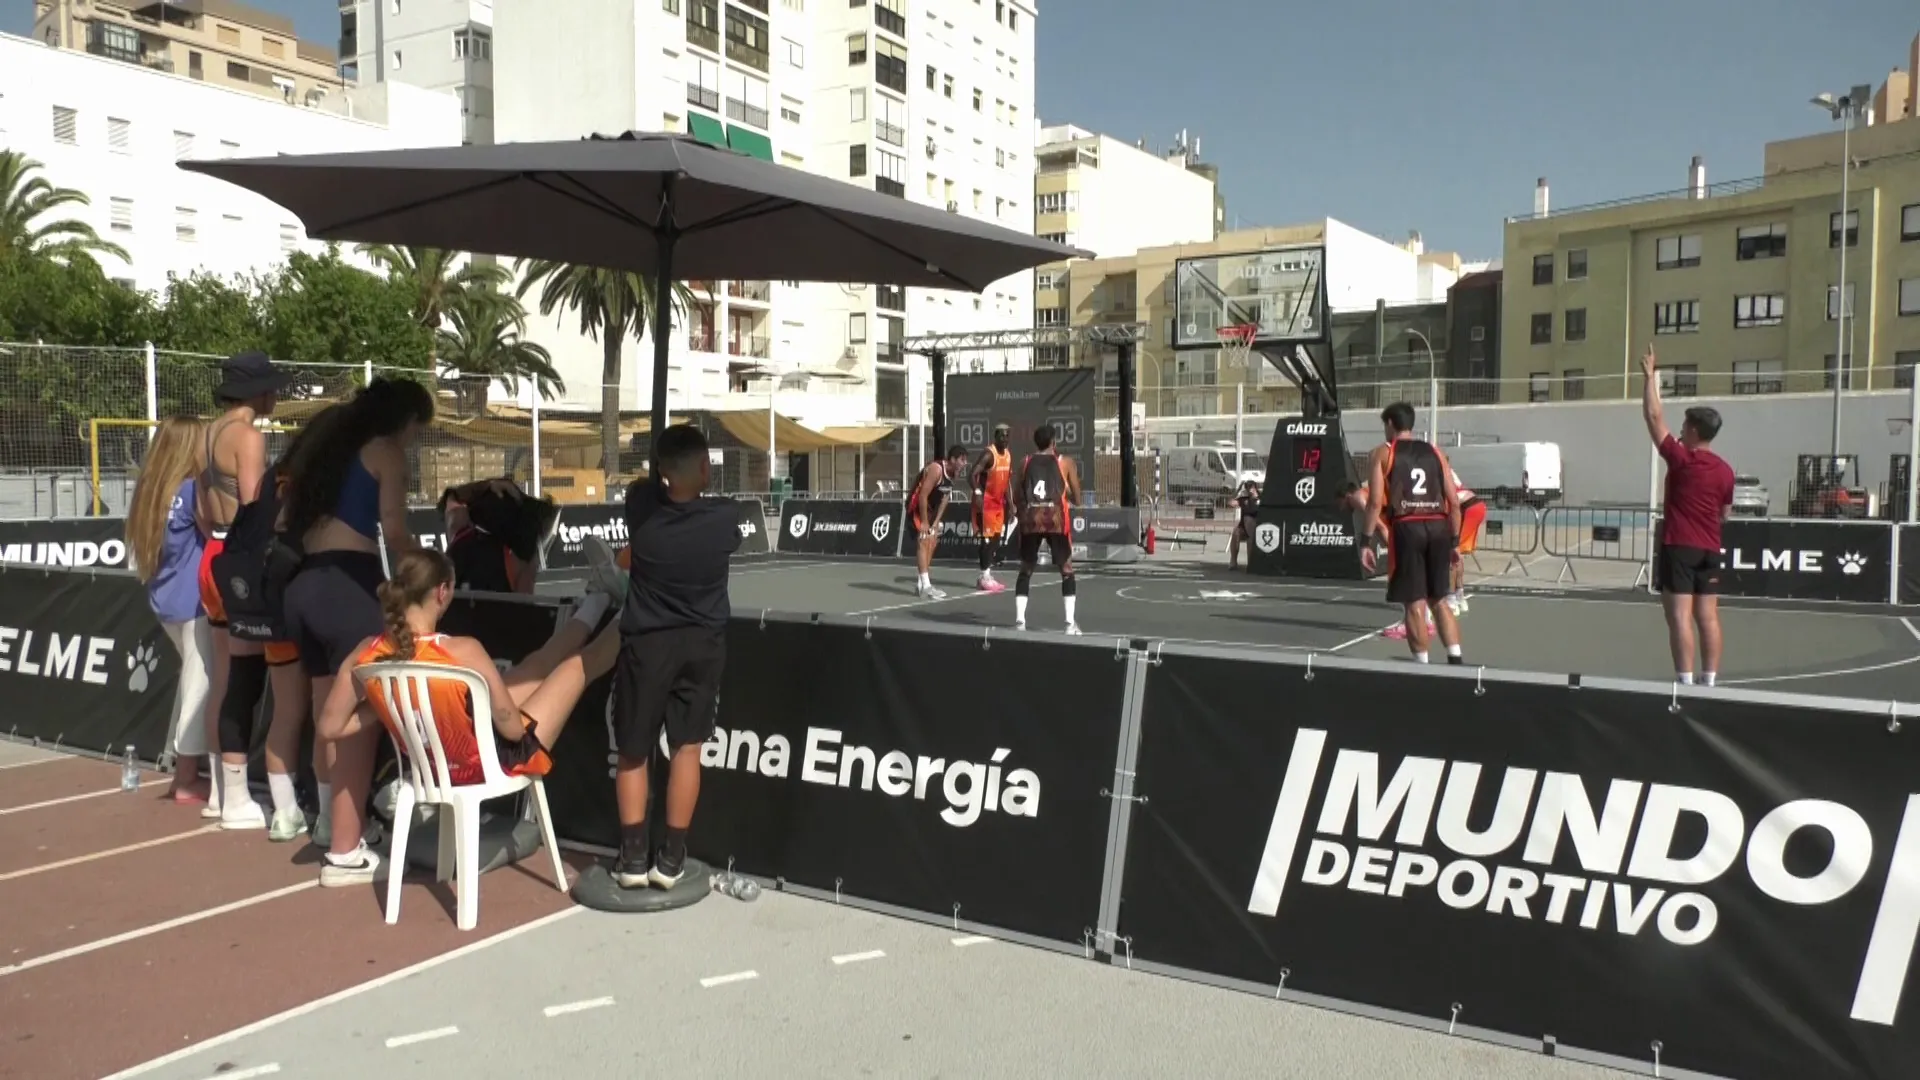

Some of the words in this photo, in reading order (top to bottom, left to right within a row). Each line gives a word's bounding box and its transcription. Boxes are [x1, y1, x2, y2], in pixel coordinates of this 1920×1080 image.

[960, 424, 983, 445] 03
[1286, 421, 1328, 435] CÁDIZ
[1033, 480, 1047, 500] 4
[1410, 468, 1428, 496] 2
[558, 517, 629, 543] tenerif
[1299, 520, 1344, 535] CÁDIZ
[659, 722, 791, 779] ana
[801, 725, 1042, 828] Energía
[1315, 747, 1874, 907] MUNDO
[1300, 838, 1720, 946] DEPORTIVO
